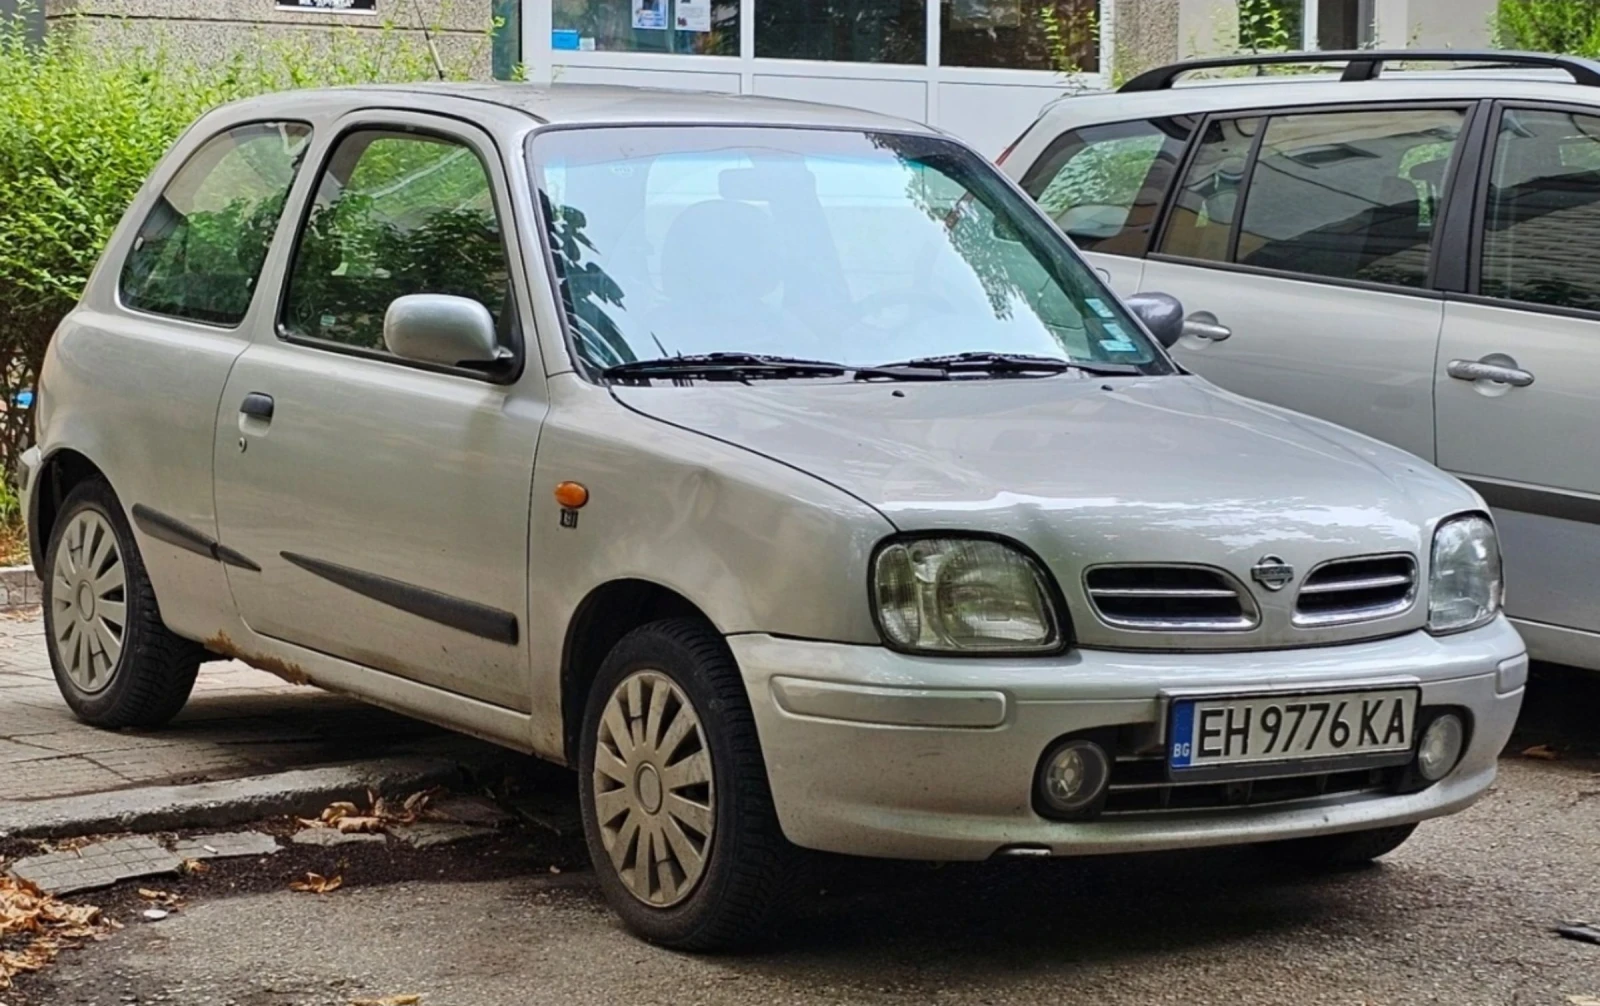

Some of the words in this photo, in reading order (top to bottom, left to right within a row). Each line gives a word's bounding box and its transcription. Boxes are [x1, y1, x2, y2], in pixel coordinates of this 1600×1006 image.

[1198, 708, 1252, 757] EH
[1260, 702, 1350, 753] 9776
[1358, 698, 1405, 746] KA
[1173, 743, 1190, 757] BG
